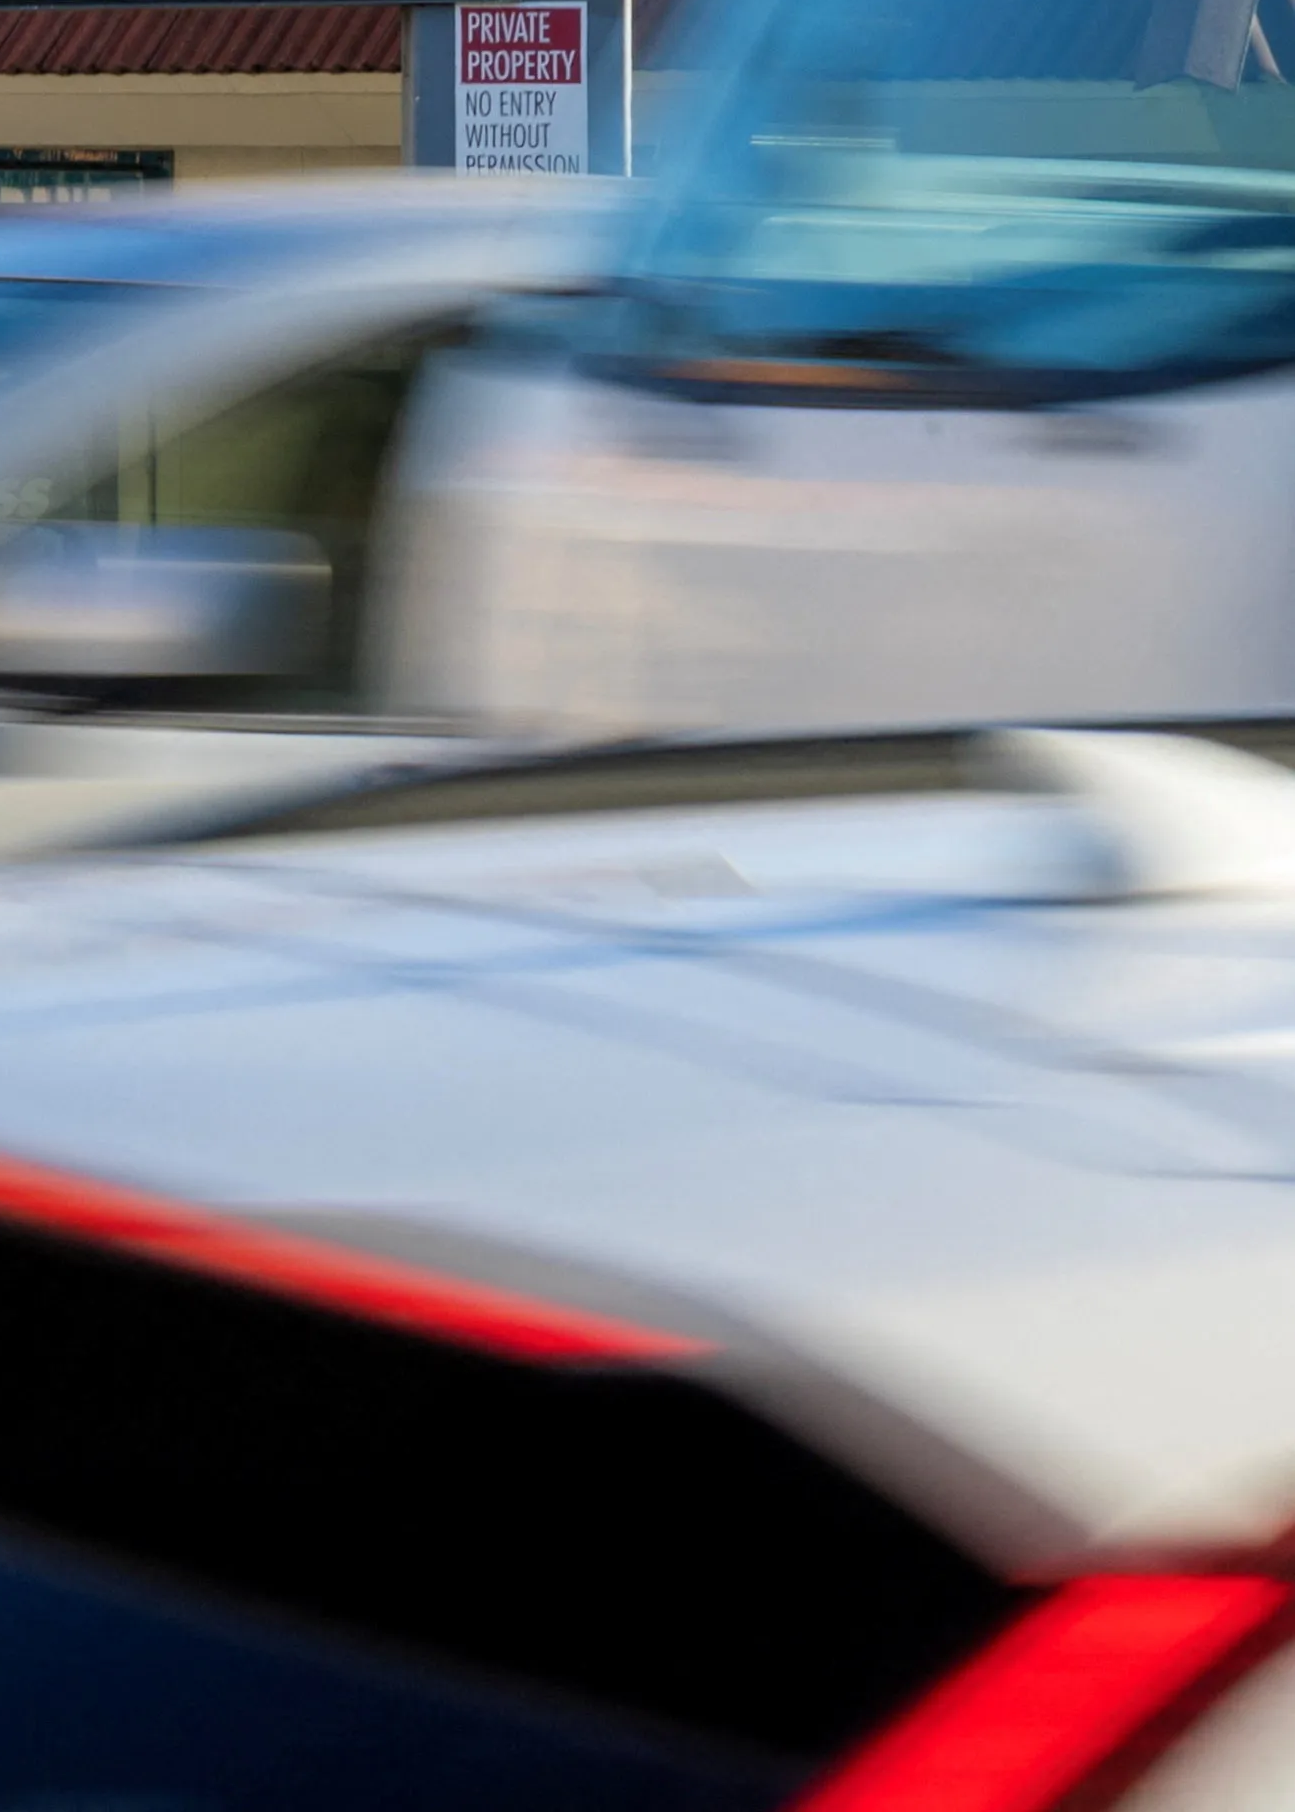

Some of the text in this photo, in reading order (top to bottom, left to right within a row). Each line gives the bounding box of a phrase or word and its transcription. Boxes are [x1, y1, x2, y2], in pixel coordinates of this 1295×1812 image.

[467, 10, 552, 44] PRIVATE
[467, 49, 576, 81] PROPERTY
[465, 90, 558, 118] NO ENTRY
[465, 122, 552, 149] WITHOUT
[465, 154, 581, 176] PERMISSION
